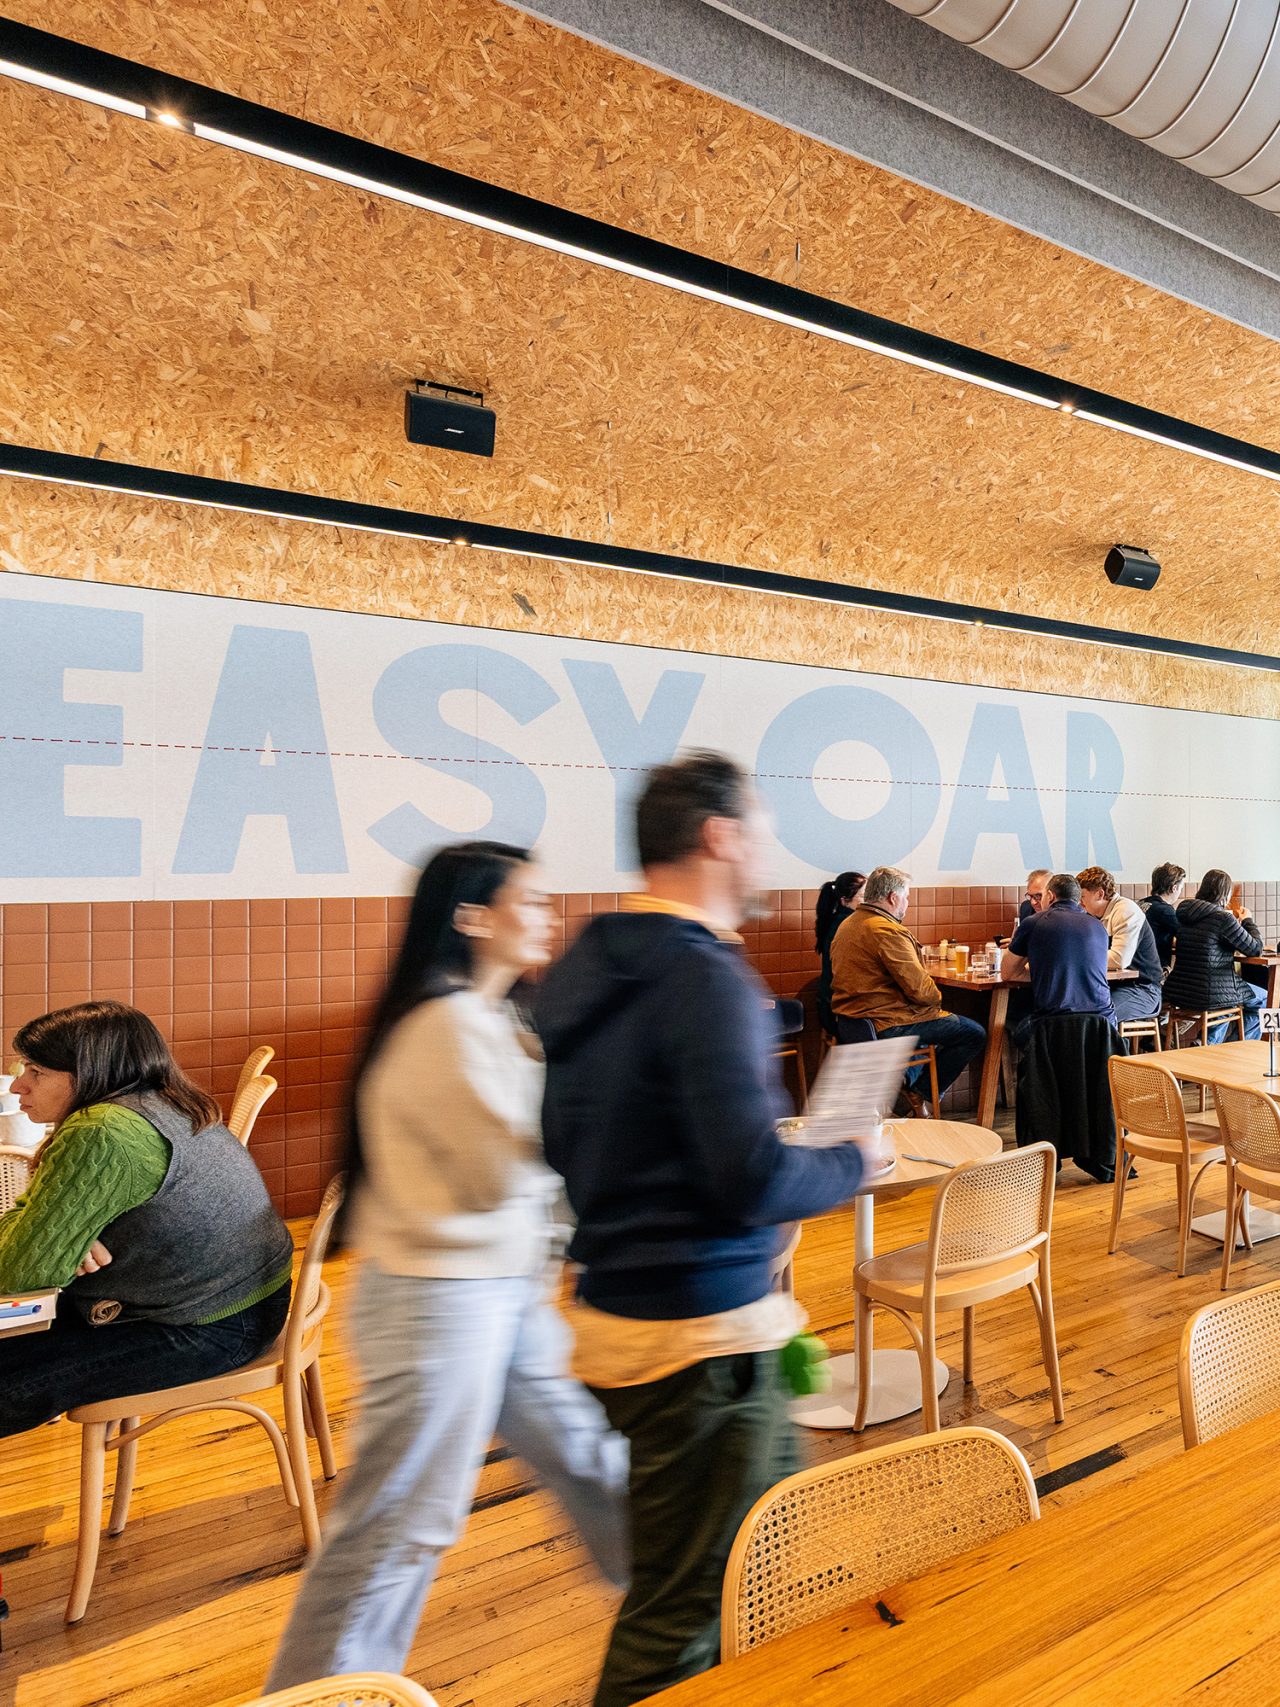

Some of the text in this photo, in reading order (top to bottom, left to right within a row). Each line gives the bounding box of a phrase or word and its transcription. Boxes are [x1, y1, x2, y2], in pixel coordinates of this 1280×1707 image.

[0, 598, 1124, 877] EASY OAR
[1263, 1012, 1280, 1028] 21
